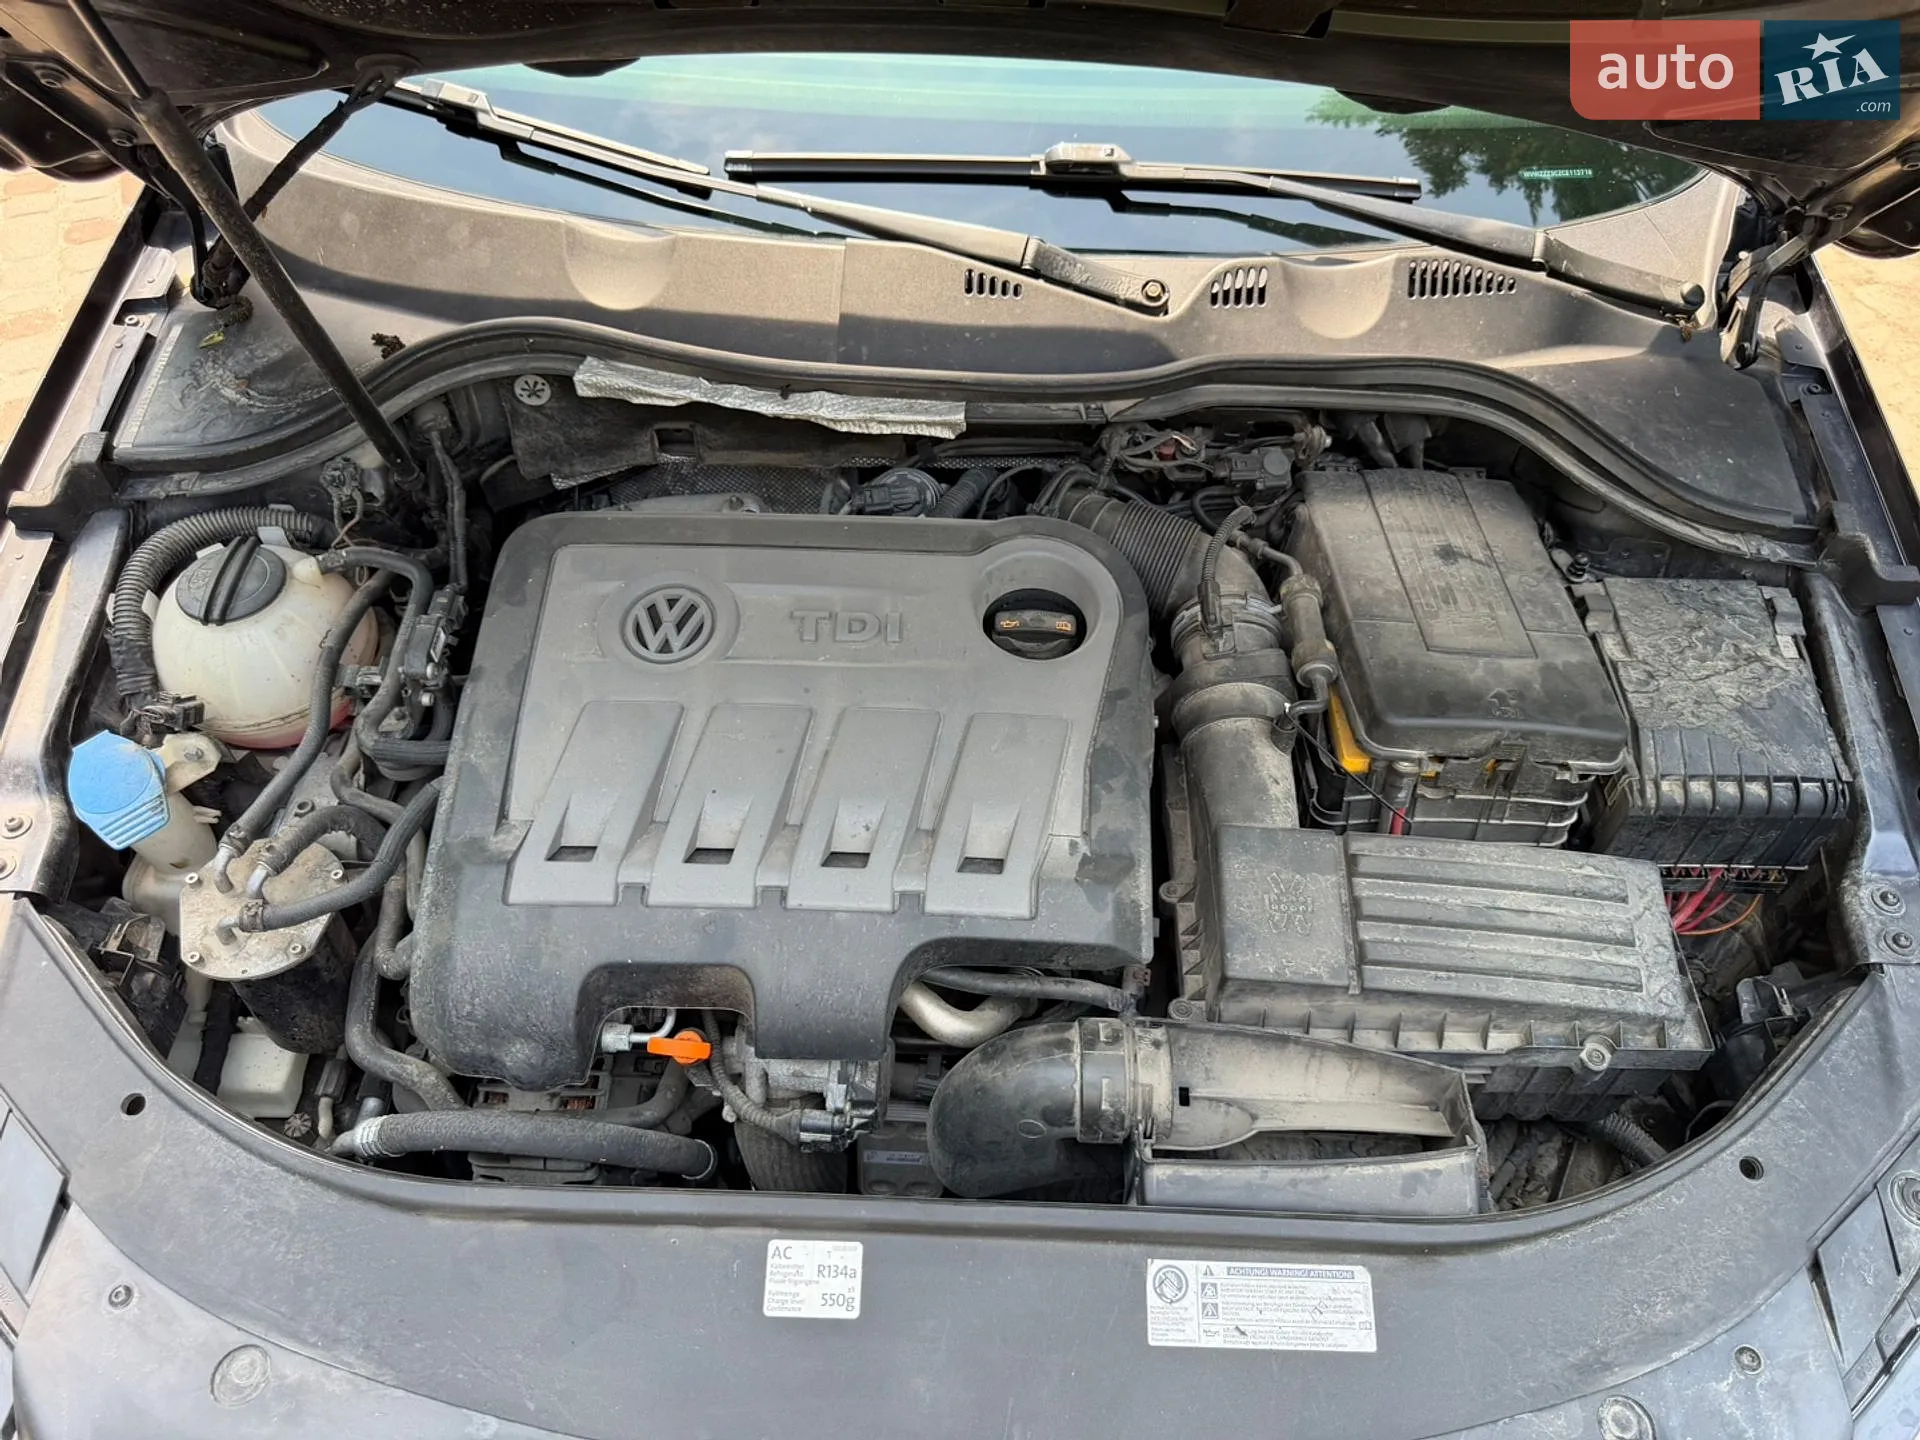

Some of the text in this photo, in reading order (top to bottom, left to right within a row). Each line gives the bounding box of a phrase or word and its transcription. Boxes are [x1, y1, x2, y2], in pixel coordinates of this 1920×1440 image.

[791, 607, 903, 645] TDI
[771, 1245, 793, 1260] AC
[817, 1263, 858, 1279] R134a
[820, 1292, 856, 1312] 550g
